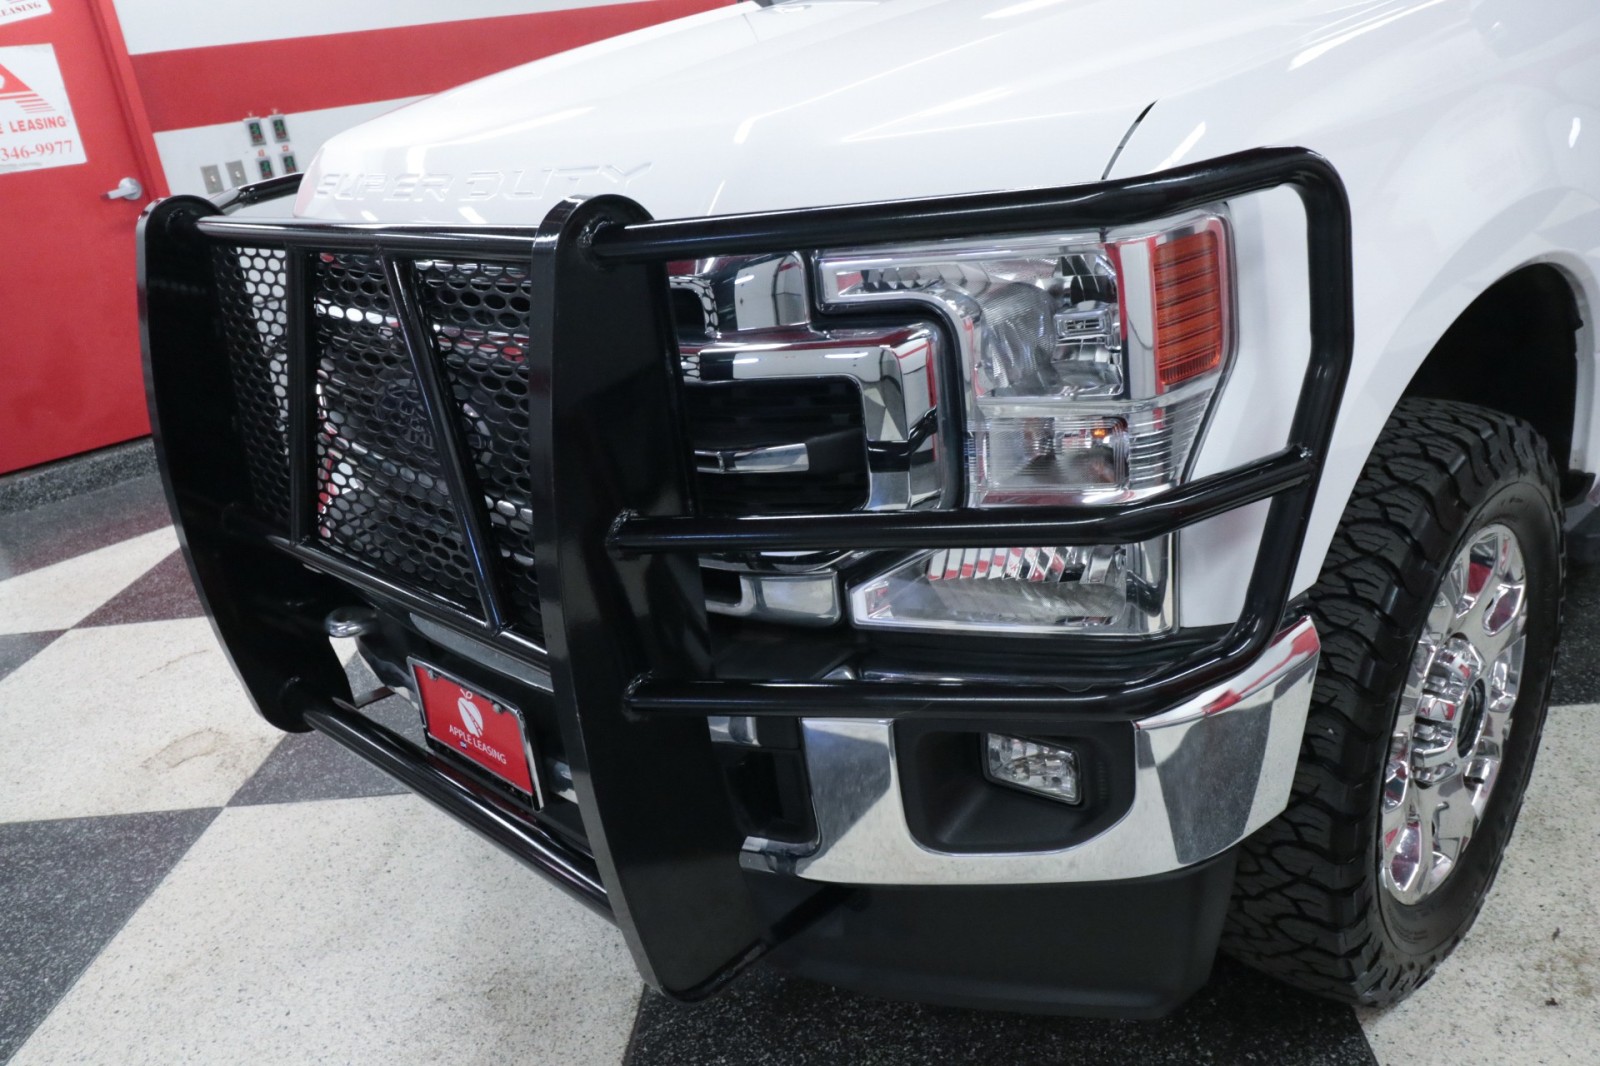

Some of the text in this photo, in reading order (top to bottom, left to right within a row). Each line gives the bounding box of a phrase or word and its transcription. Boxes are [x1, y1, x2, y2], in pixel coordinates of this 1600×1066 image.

[0, 2, 42, 17] EASING
[9, 115, 67, 133] LEASING
[0, 140, 72, 161] 346-9977
[313, 161, 653, 202] SUPER DUTY
[449, 724, 507, 765] APPLE LEASING
